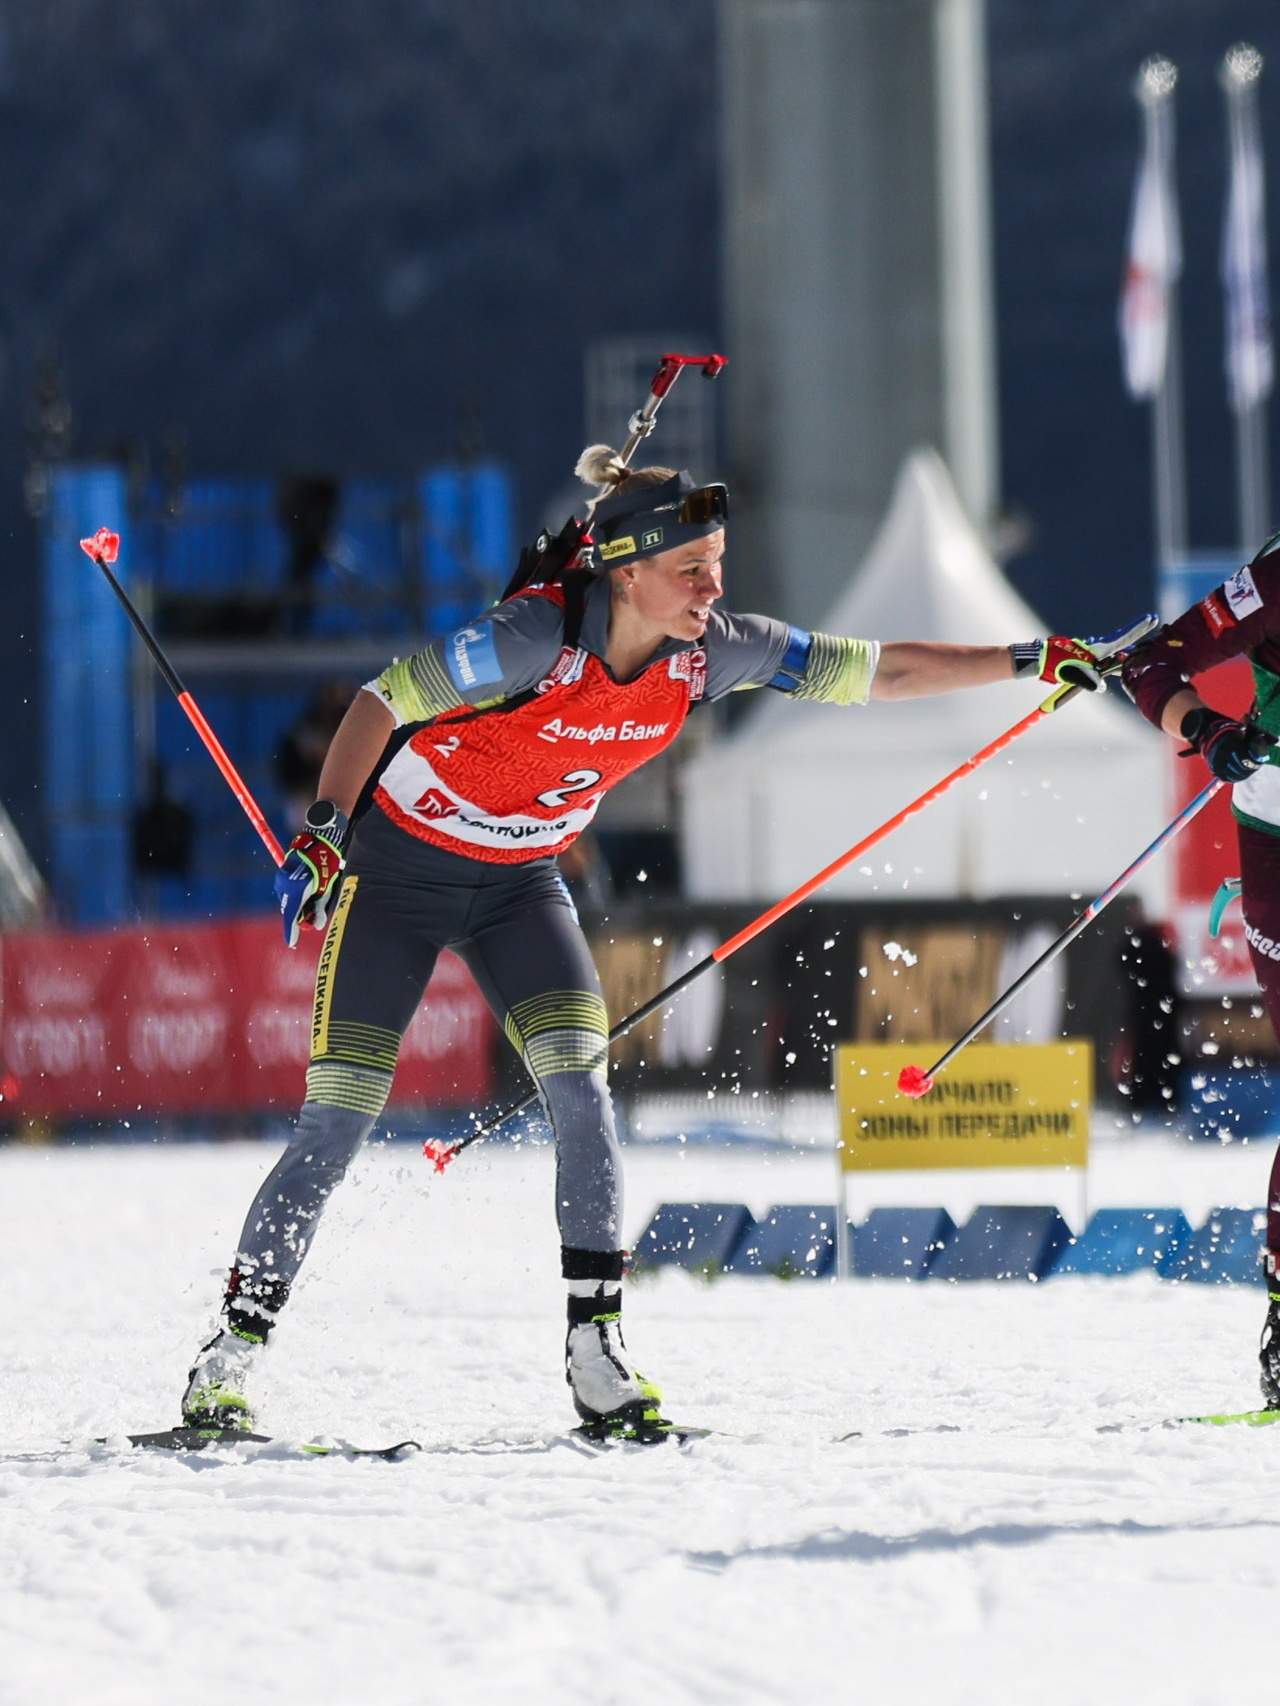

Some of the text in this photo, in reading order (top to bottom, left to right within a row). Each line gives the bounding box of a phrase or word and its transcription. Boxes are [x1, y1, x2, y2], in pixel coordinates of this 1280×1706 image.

[1054, 640, 1089, 662] LEKI
[537, 718, 670, 745] Альфа Банк
[433, 736, 460, 759] 2
[536, 769, 602, 808] 2
[319, 850, 329, 892] LEKI
[856, 1111, 1073, 1143] ЗОНЫ ПЕРЕДАЧИ
